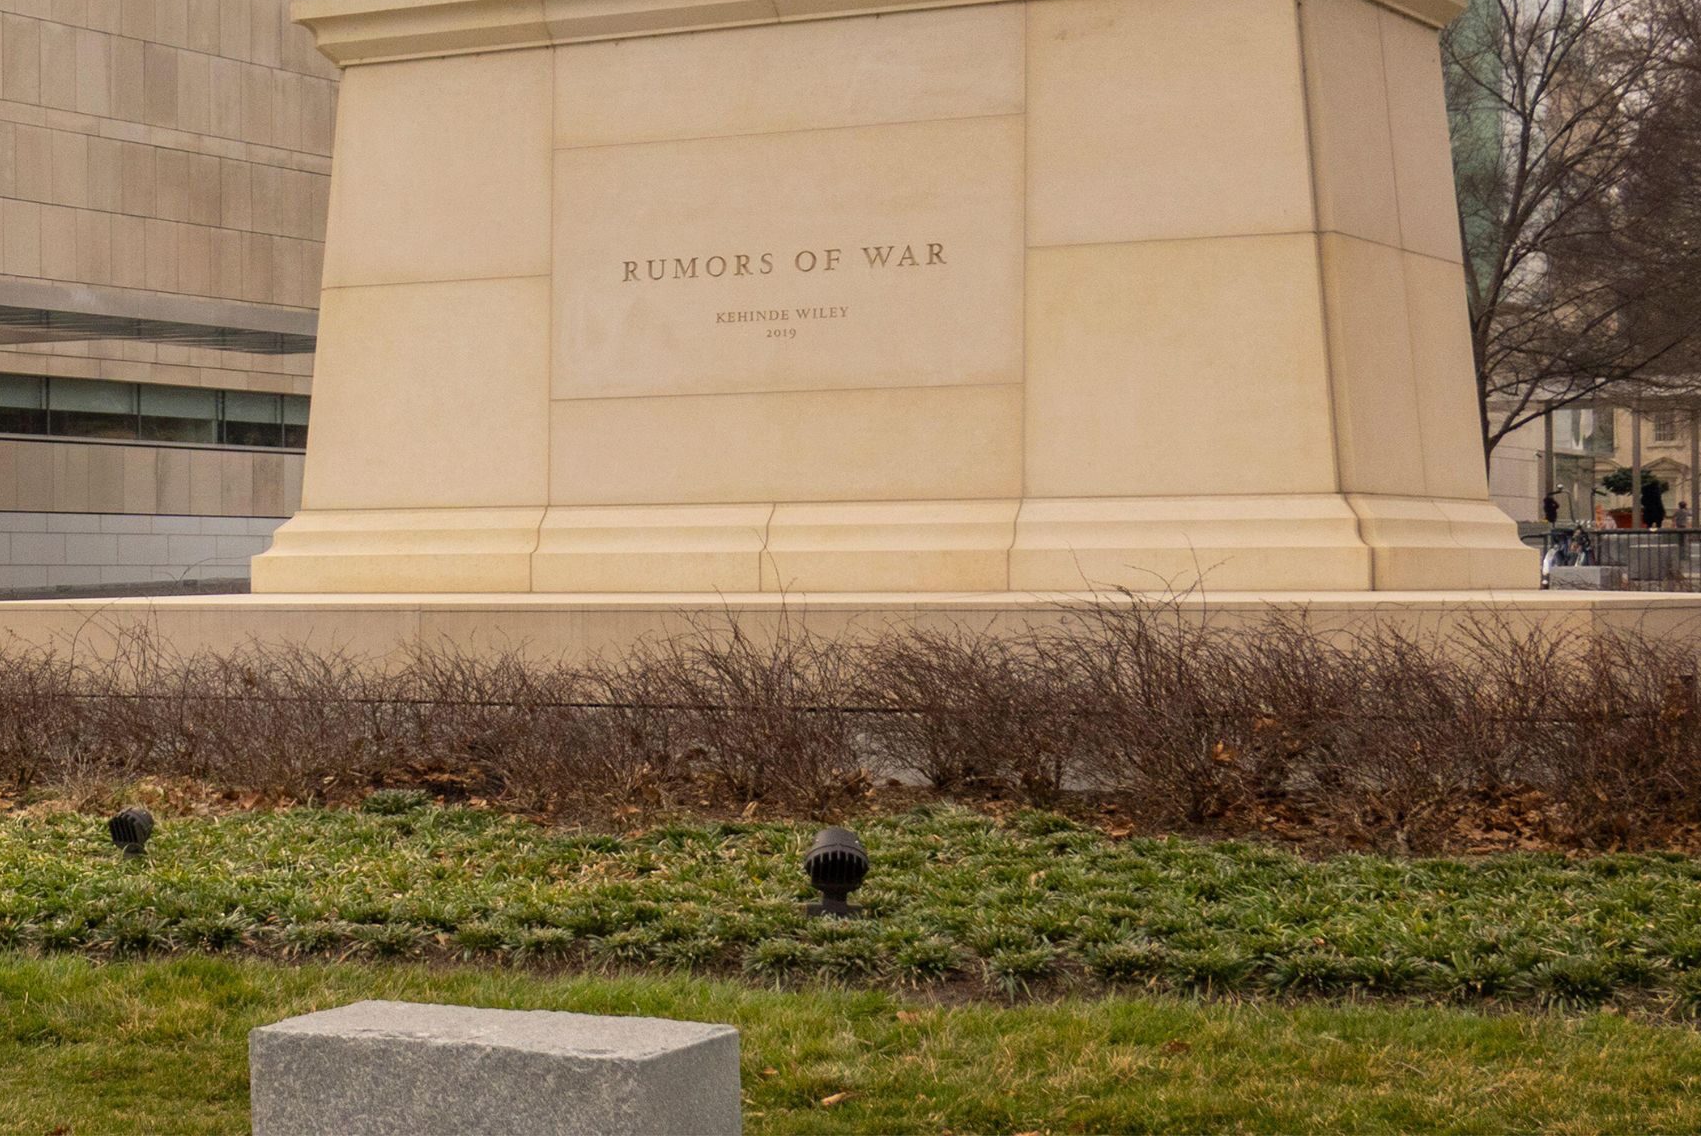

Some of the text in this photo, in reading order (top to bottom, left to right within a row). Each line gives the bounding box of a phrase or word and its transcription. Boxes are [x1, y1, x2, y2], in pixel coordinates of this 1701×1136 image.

[622, 243, 948, 282] RUMORS OF WAR
[715, 306, 850, 324] KEHINDE WILEY
[766, 327, 797, 339] 2019
